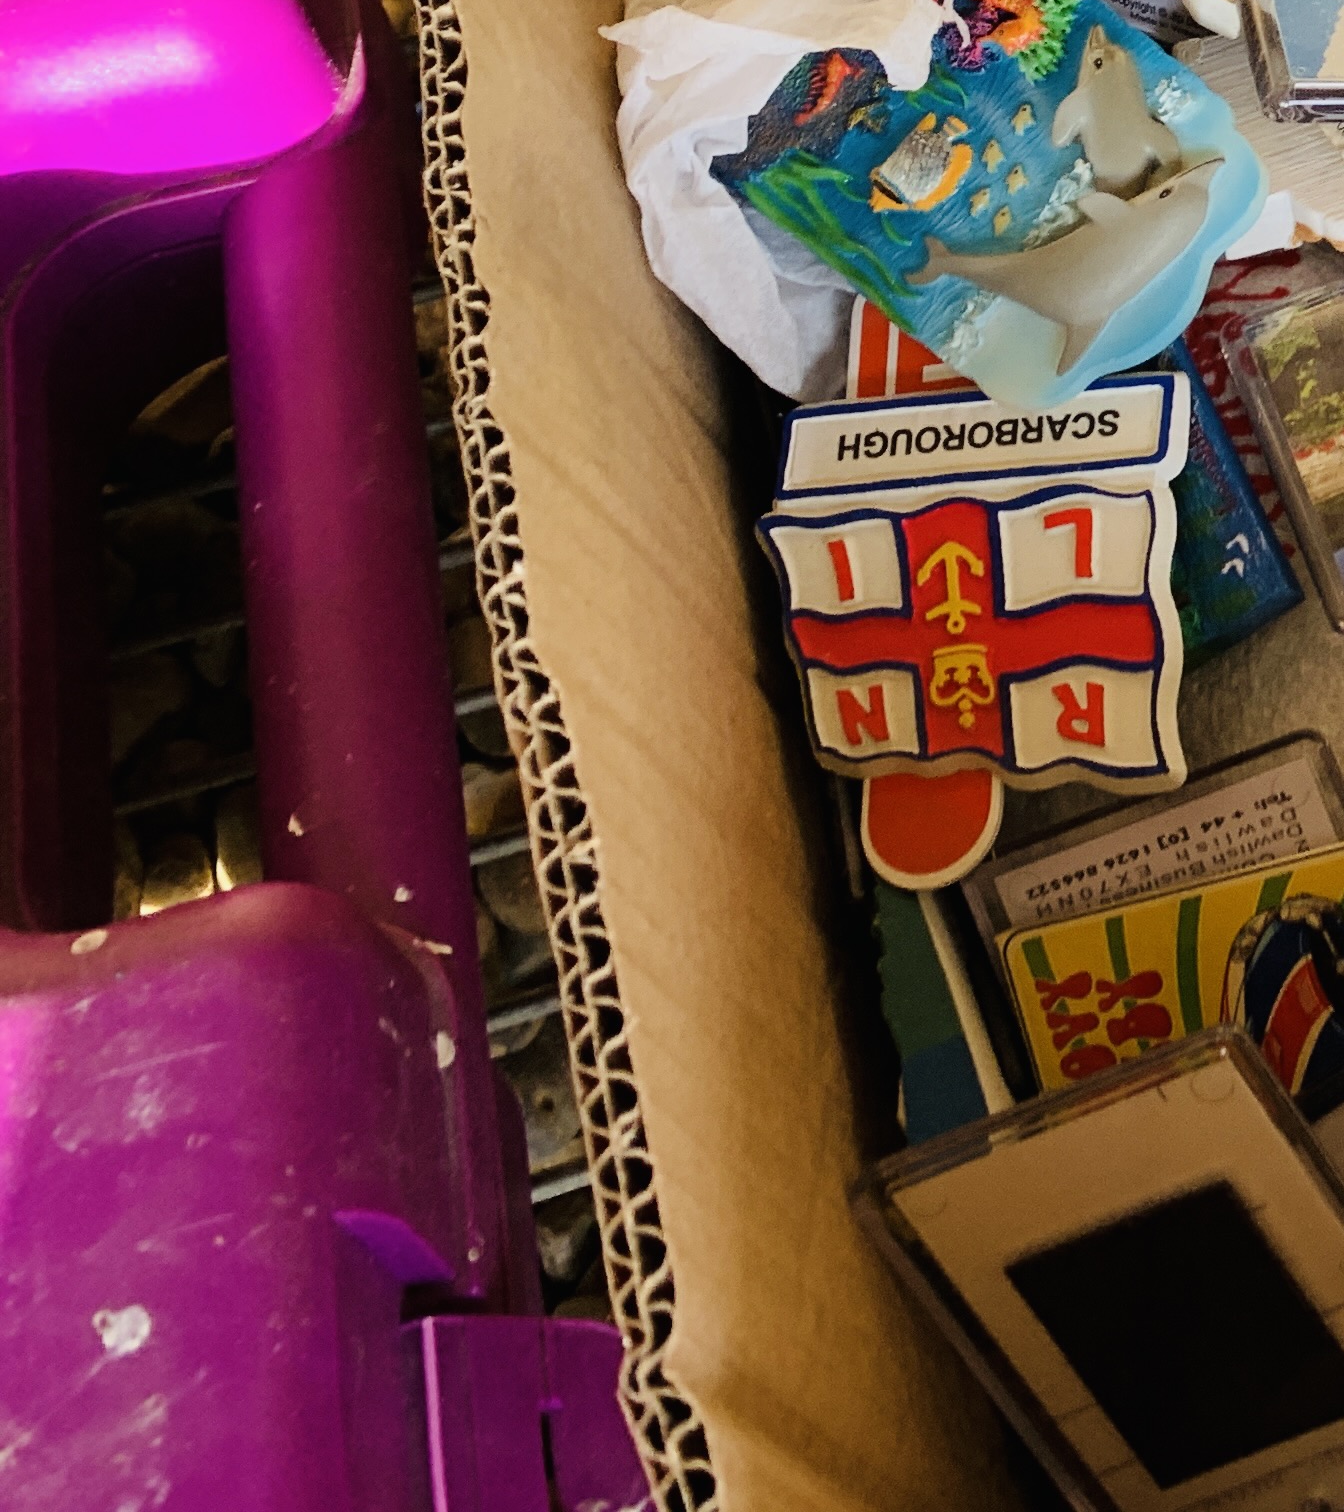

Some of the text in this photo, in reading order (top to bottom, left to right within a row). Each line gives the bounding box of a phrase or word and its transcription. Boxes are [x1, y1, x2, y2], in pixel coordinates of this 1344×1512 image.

[837, 410, 1121, 462] SCARBOROUGH
[827, 507, 1095, 603] L I
[836, 682, 1107, 749] R N
[1171, 805, 1301, 865] Dawlish
[1209, 821, 1306, 869] Dawlish
